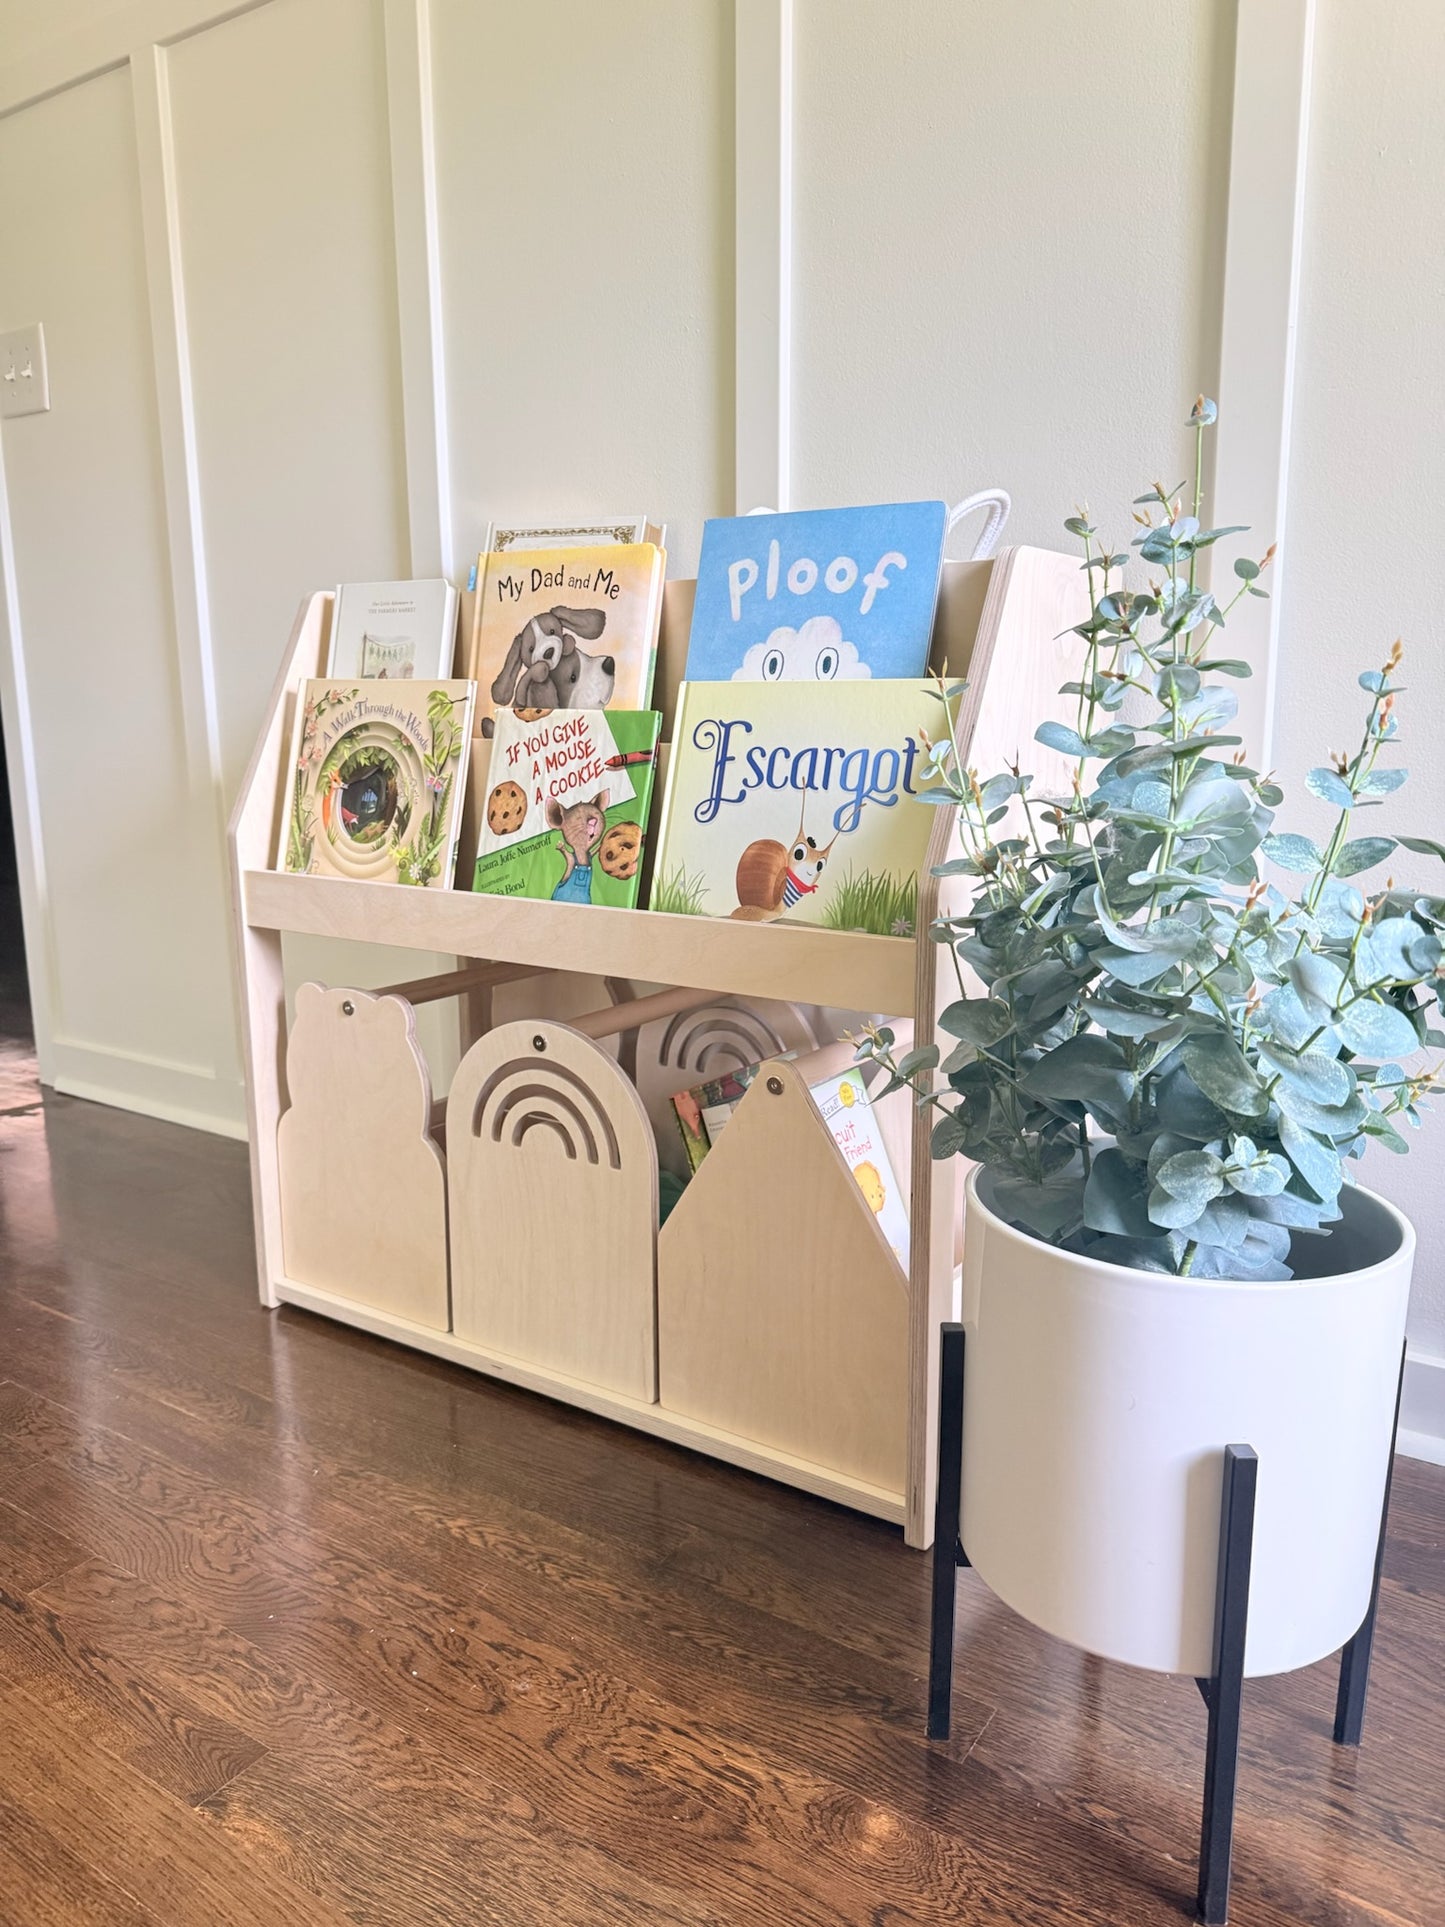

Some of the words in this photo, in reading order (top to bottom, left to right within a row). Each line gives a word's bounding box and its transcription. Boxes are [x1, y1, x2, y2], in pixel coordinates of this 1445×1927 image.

[498, 575, 524, 602] My
[531, 564, 565, 592] Dad
[568, 574, 591, 589] and
[593, 568, 620, 600] Me
[728, 539, 907, 621] ploof
[321, 731, 332, 747] A
[331, 708, 357, 733] Walk
[355, 697, 395, 717] Through
[395, 709, 407, 721] the
[405, 711, 429, 752] Woods
[506, 741, 520, 767] IF
[523, 728, 549, 757] YOU
[552, 715, 589, 744] GIVE
[532, 760, 541, 780] A
[545, 738, 596, 773] MOUSE
[535, 787, 543, 805] A
[550, 757, 605, 797] COOKIE
[693, 719, 920, 832] Escargot
[478, 861, 499, 874] Laura
[499, 851, 516, 866] Joffe
[517, 834, 552, 856] Numeroff
[505, 878, 525, 895] Bond
[844, 1135, 872, 1161] Friend
